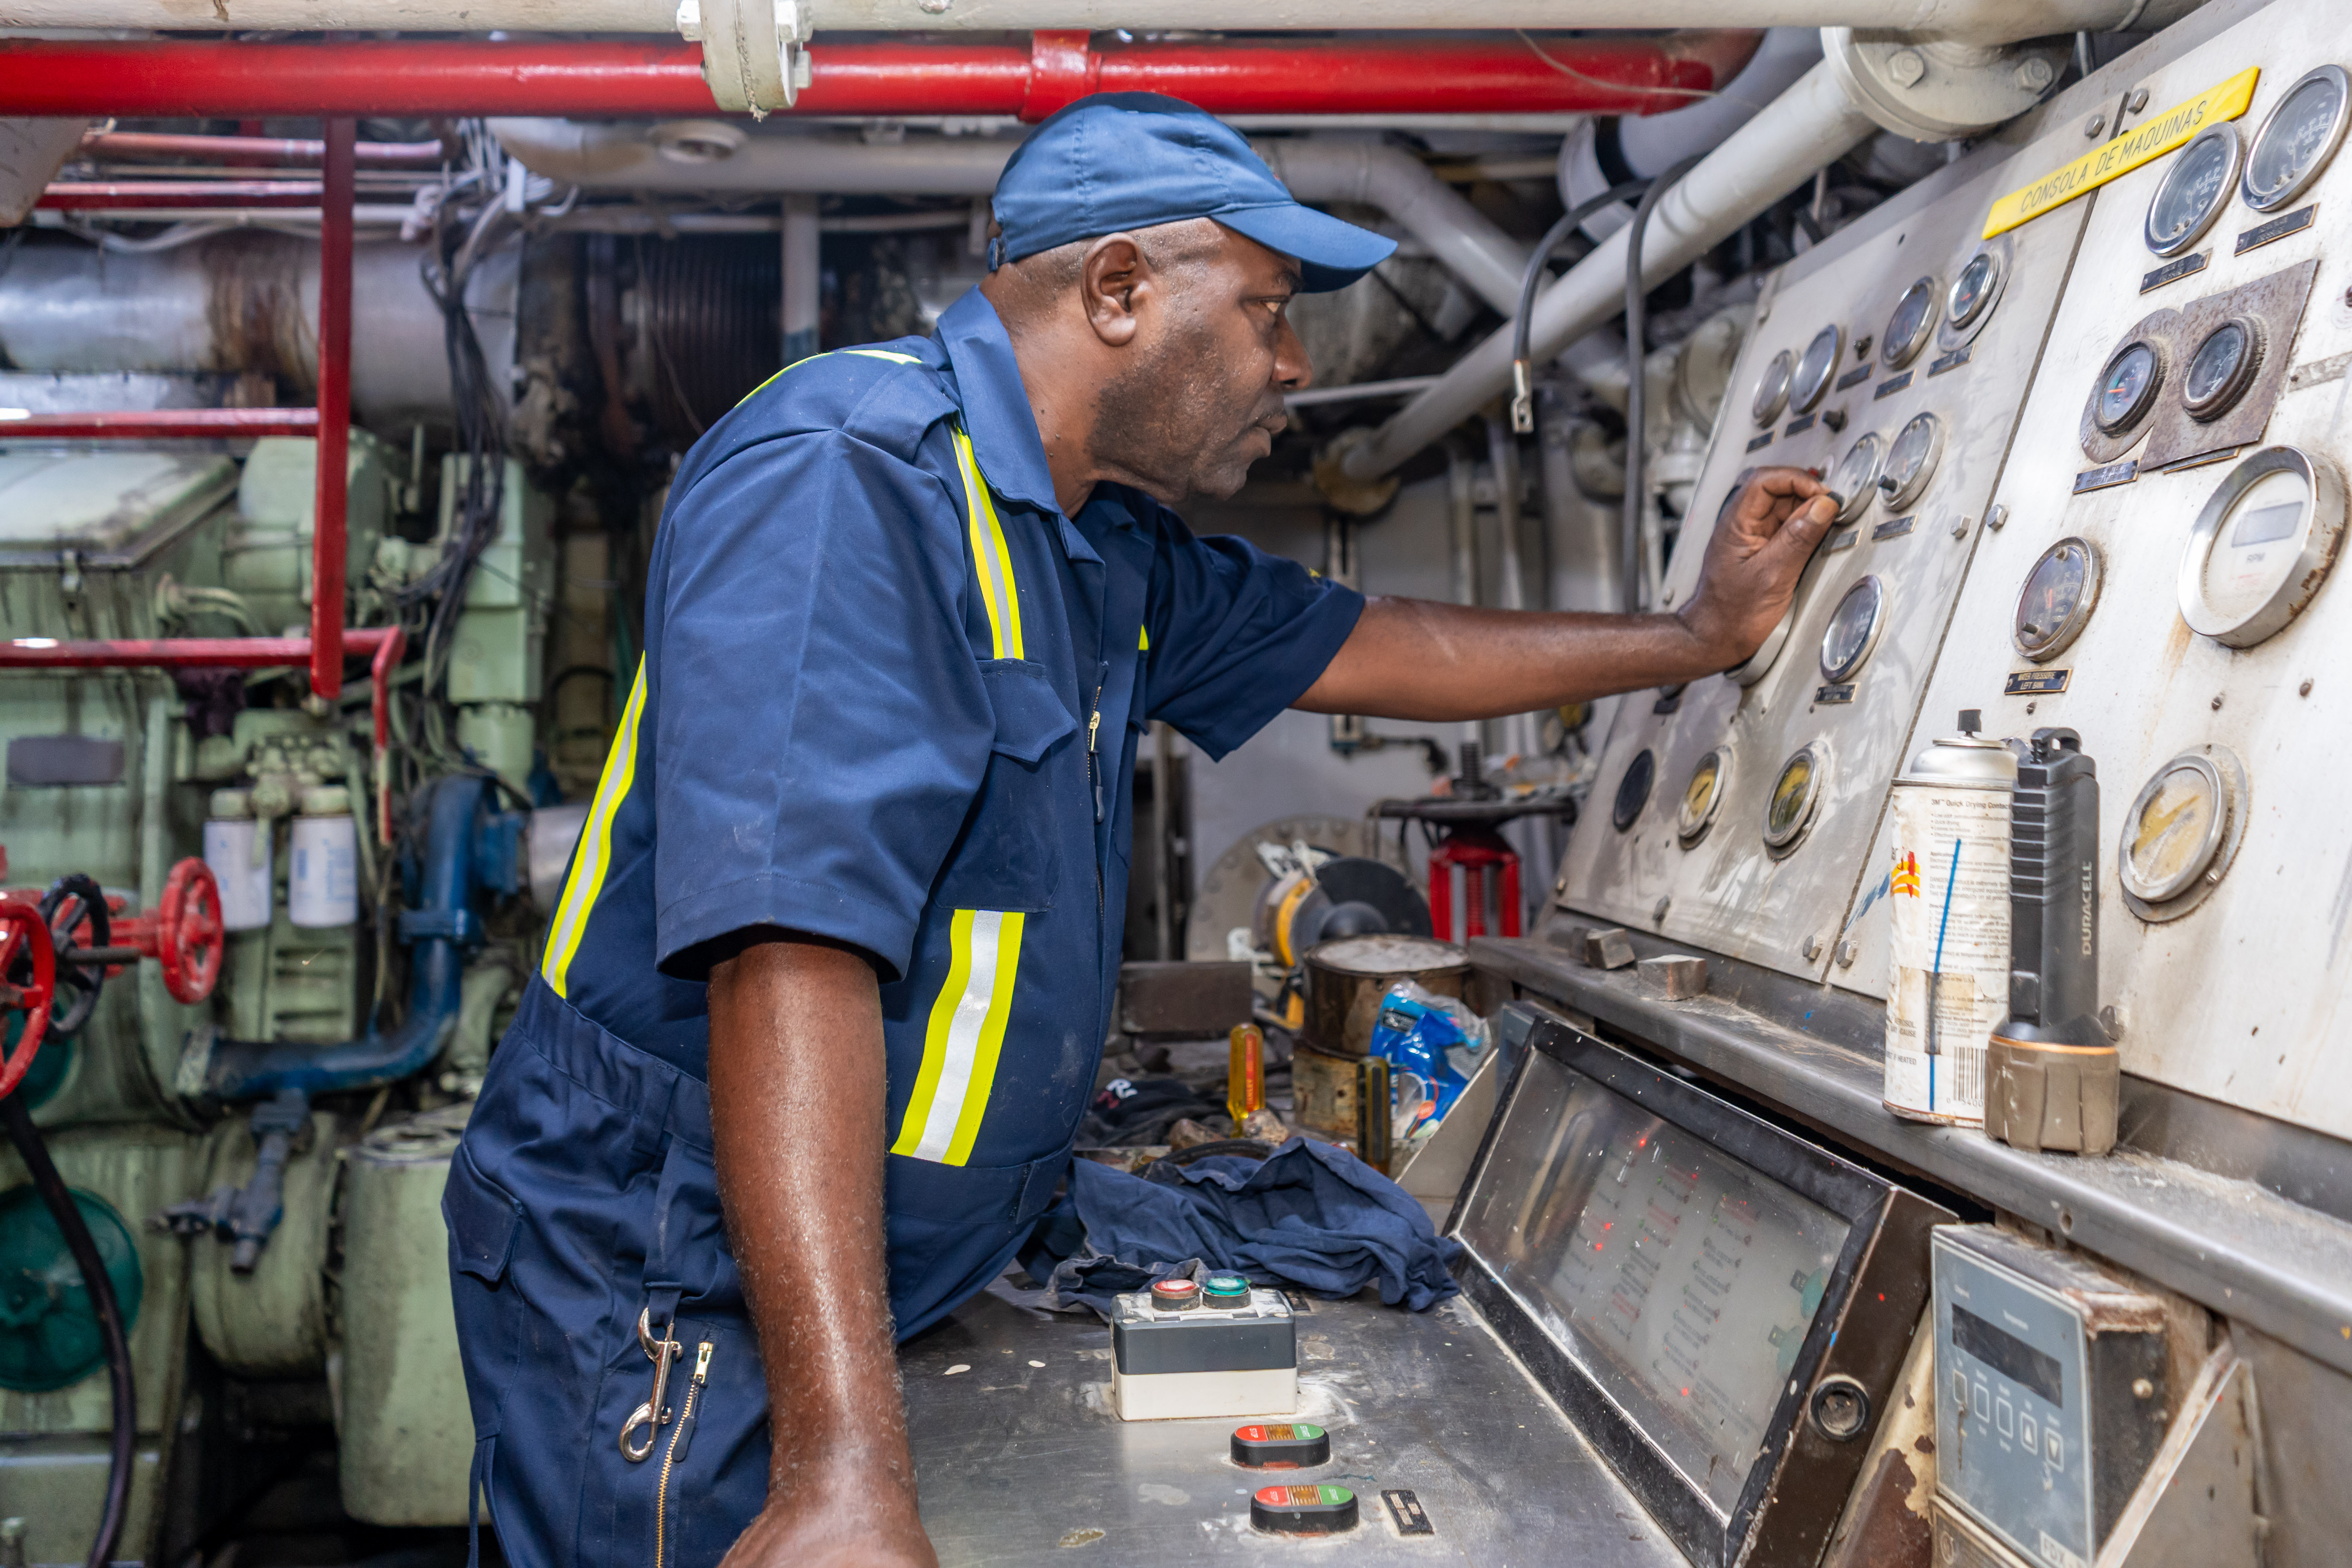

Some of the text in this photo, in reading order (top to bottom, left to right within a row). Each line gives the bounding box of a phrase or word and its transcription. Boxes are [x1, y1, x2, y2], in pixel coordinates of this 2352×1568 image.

[2021, 100, 2207, 213] CONSOLA DE MAQUINAS
[2246, 552, 2265, 564] RPM
[2020, 682, 2033, 690] LEFT
[1965, 801, 1986, 809] Drying
[2082, 861, 2092, 956] DURACELL
[1899, 1028, 1916, 1038] CAUSE
[1898, 1054, 1916, 1065] HEATED
[1249, 1428, 1259, 1438] STOP
[1299, 1425, 1310, 1437] START
[1270, 1491, 1279, 1502] STOP
